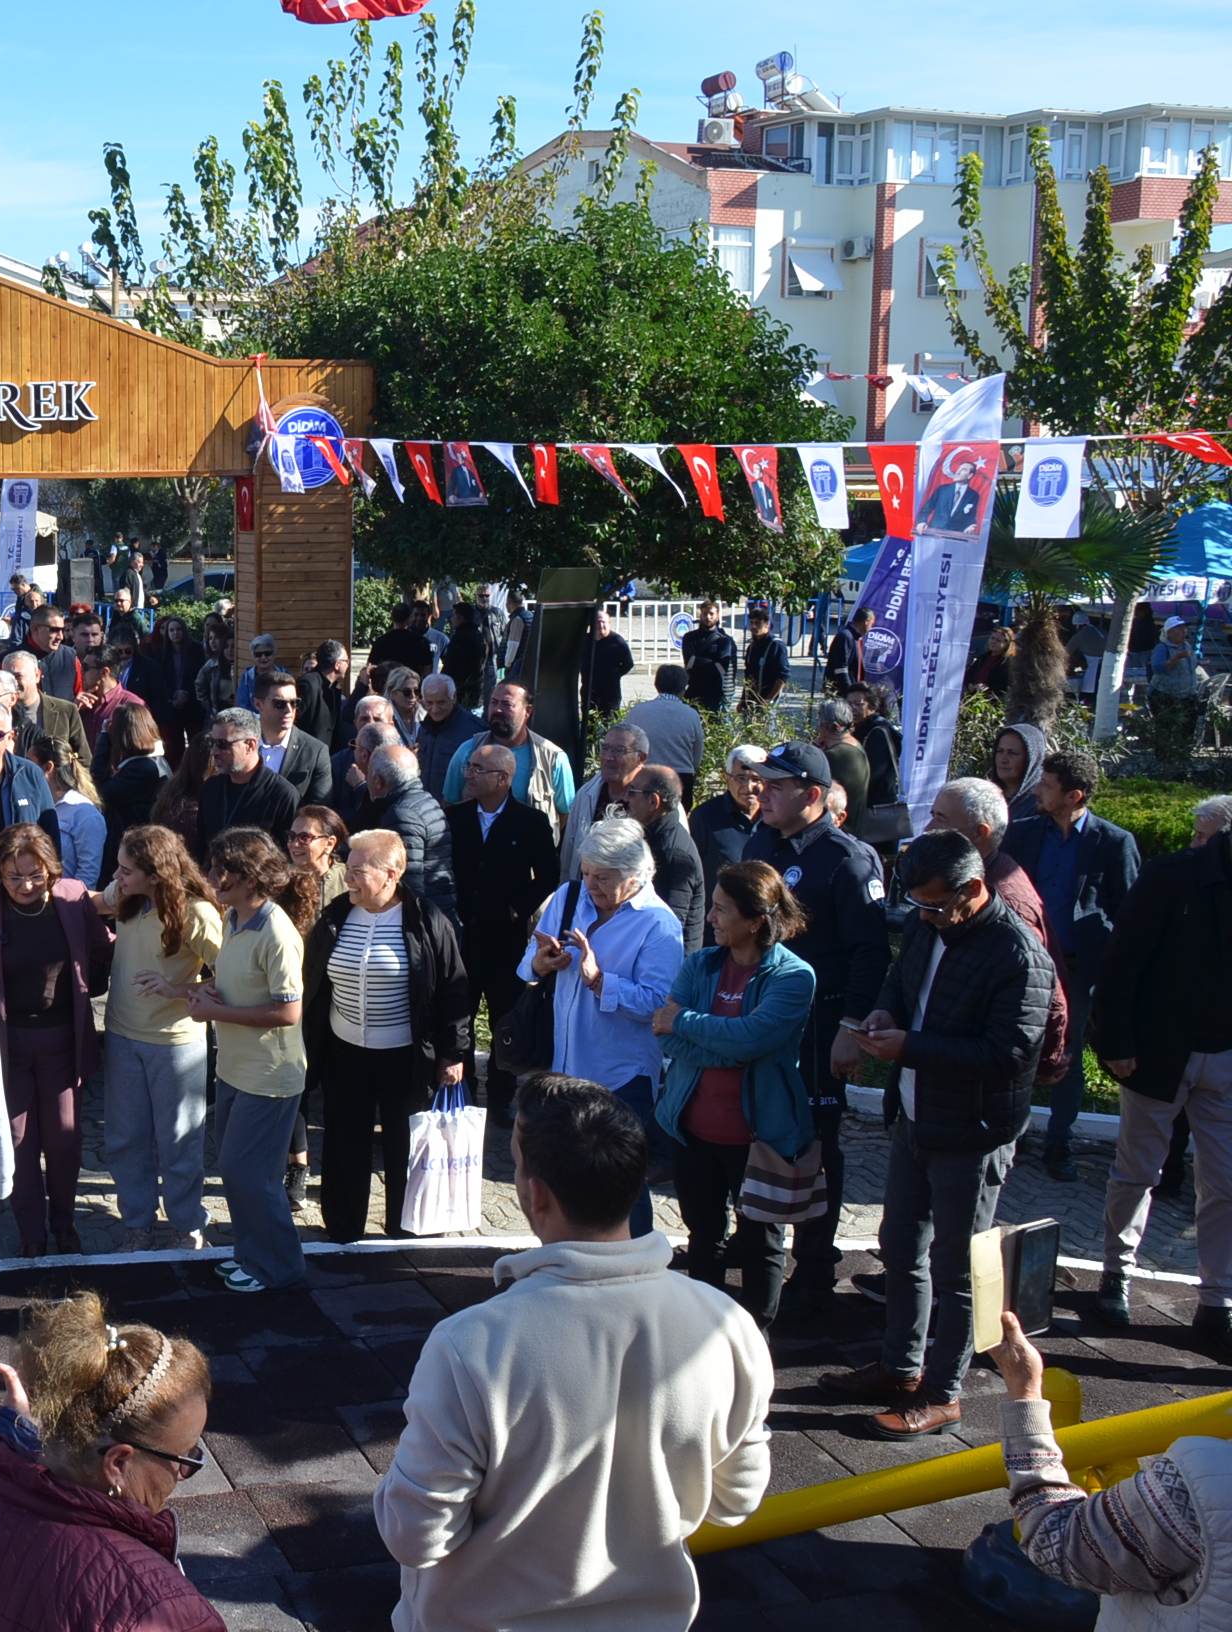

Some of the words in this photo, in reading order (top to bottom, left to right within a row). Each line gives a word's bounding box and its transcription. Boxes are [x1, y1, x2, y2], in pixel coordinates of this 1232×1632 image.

[287, 419, 326, 433] DİDİM
[885, 579, 910, 621] DİDİM
[808, 1096, 838, 1105] ZBITA
